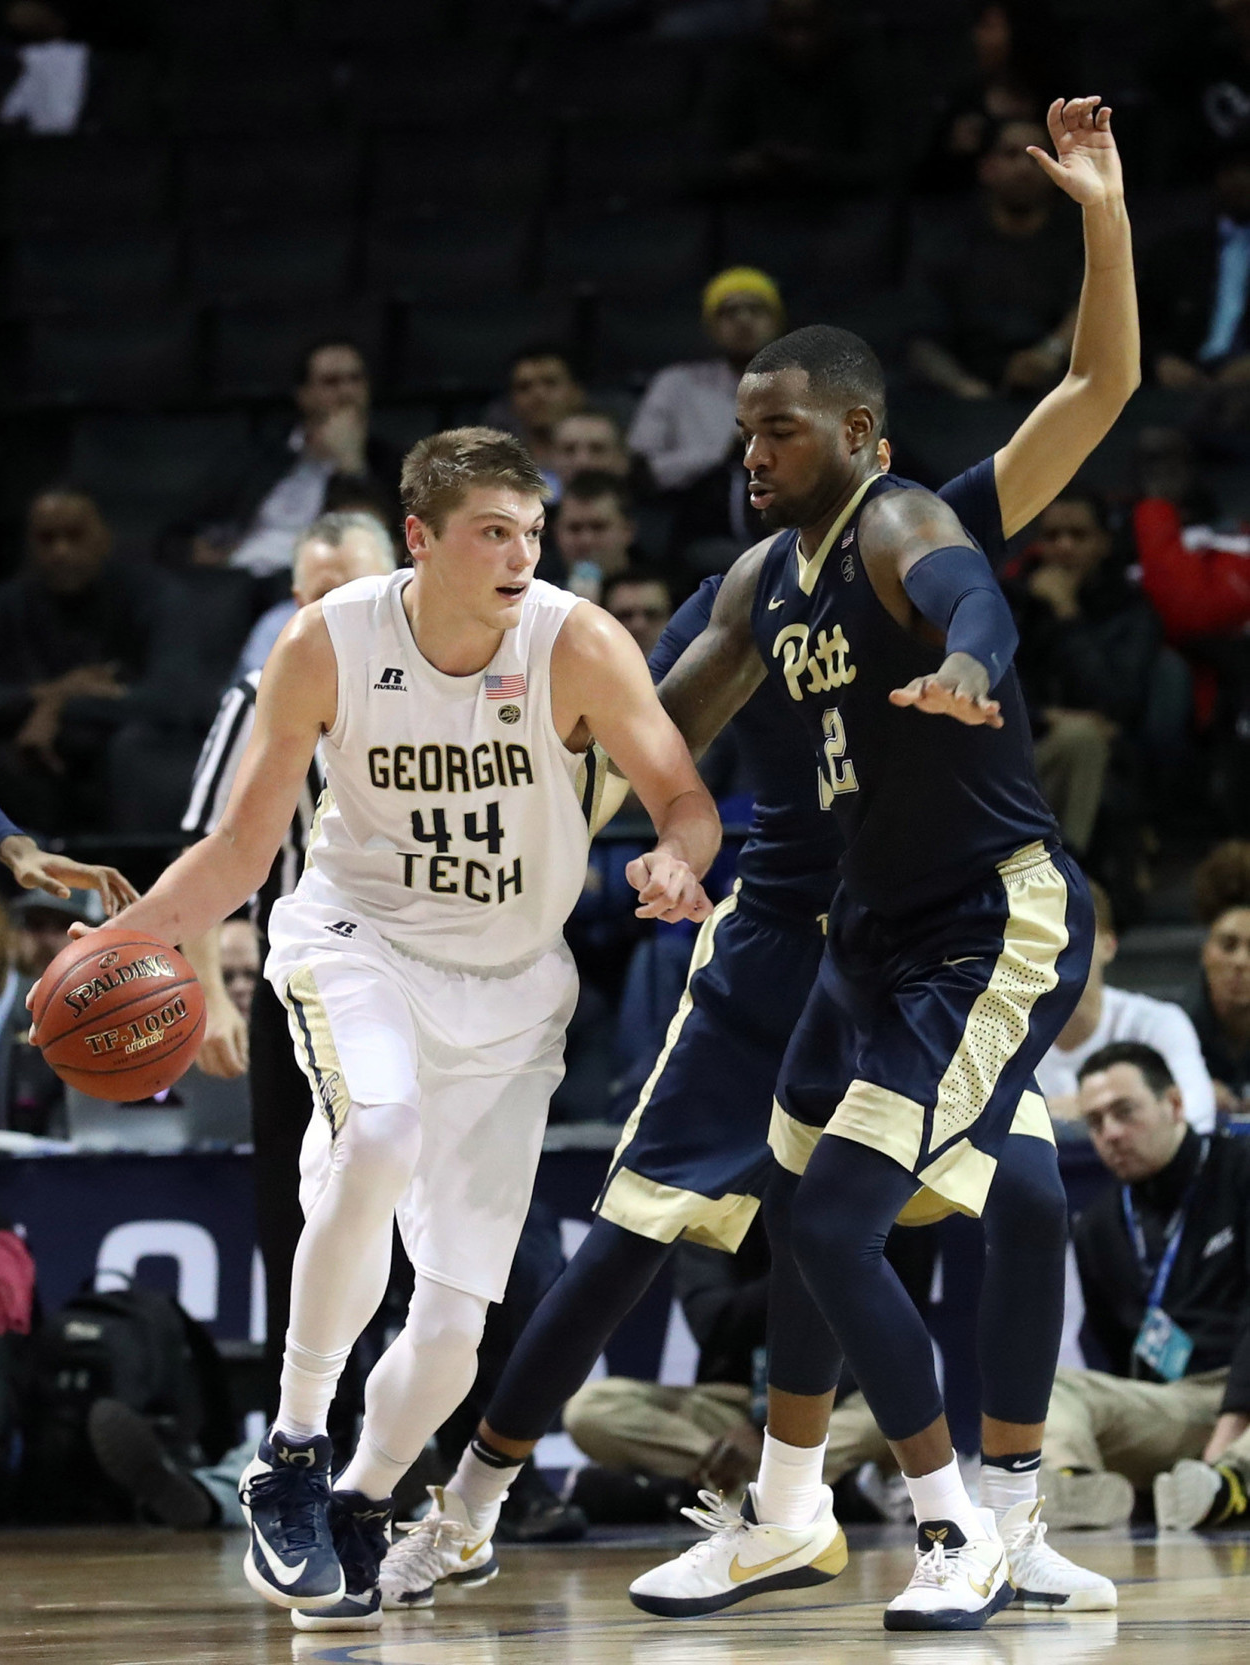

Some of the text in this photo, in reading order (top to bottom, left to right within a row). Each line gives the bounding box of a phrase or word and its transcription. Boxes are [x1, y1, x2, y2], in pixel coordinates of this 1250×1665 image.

[373, 684, 407, 692] RUSSELL
[772, 623, 857, 701] Pitt
[367, 740, 534, 793] GEORGIA
[411, 801, 504, 854] 44
[395, 852, 523, 905] TECH
[63, 953, 177, 1019] SPALDING
[85, 997, 188, 1054] TF-1000
